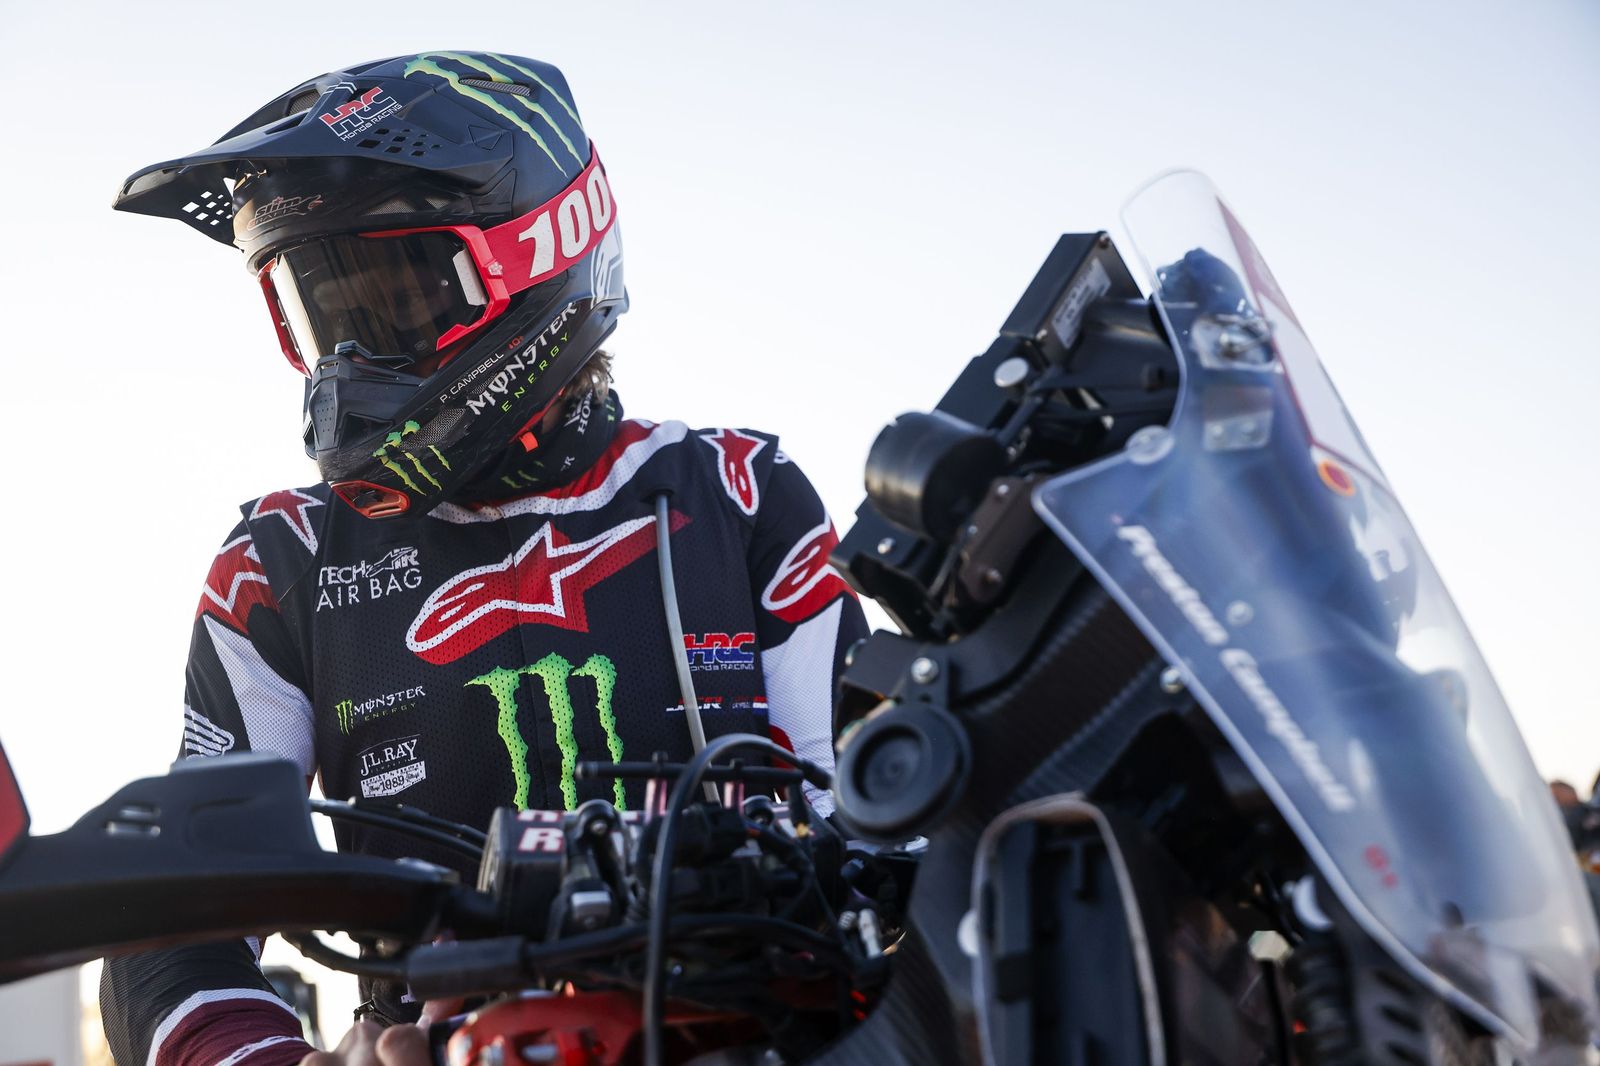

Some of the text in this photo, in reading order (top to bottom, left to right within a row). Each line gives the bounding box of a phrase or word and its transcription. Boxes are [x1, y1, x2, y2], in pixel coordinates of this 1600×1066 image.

[319, 86, 398, 137] HRC
[340, 104, 403, 141] Honda RACING
[440, 394, 451, 404] P.
[450, 352, 504, 395] CAMPBELL
[465, 302, 577, 415] MONSTER
[501, 332, 568, 413] ENERGY
[316, 568, 422, 612] AIR BAG
[683, 632, 755, 664] HRC
[689, 663, 754, 672] onda RACING
[353, 685, 426, 716] MONSTER
[380, 775, 405, 792] 1989
